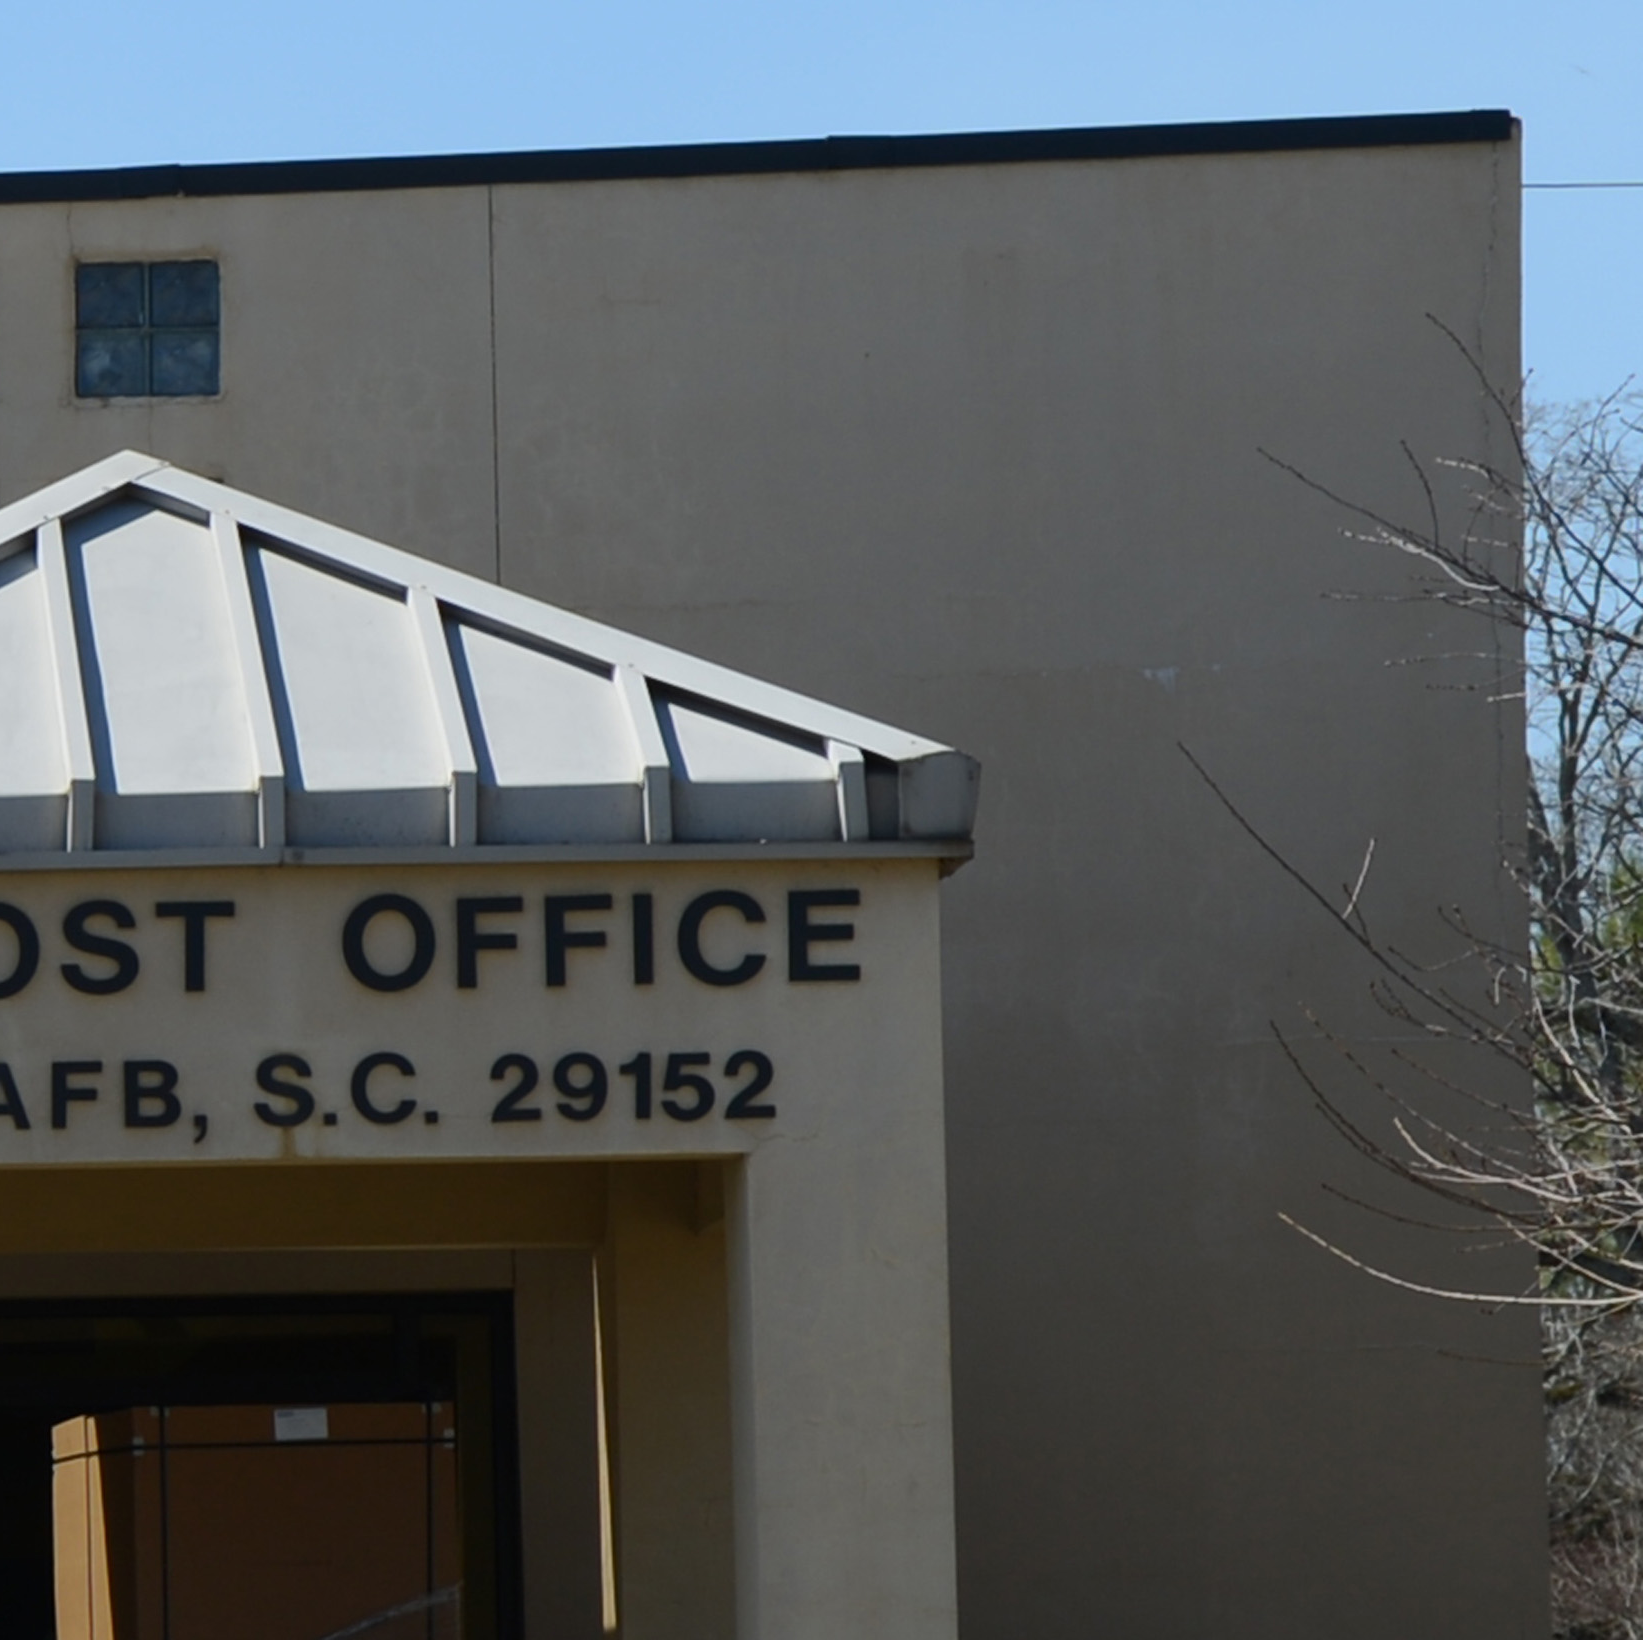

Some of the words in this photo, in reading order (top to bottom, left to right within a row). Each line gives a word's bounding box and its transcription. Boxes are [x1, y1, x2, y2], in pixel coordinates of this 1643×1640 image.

[339, 886, 864, 994] OFFICE
[253, 1051, 440, 1128] S.C.
[489, 1050, 777, 1125] 29152
